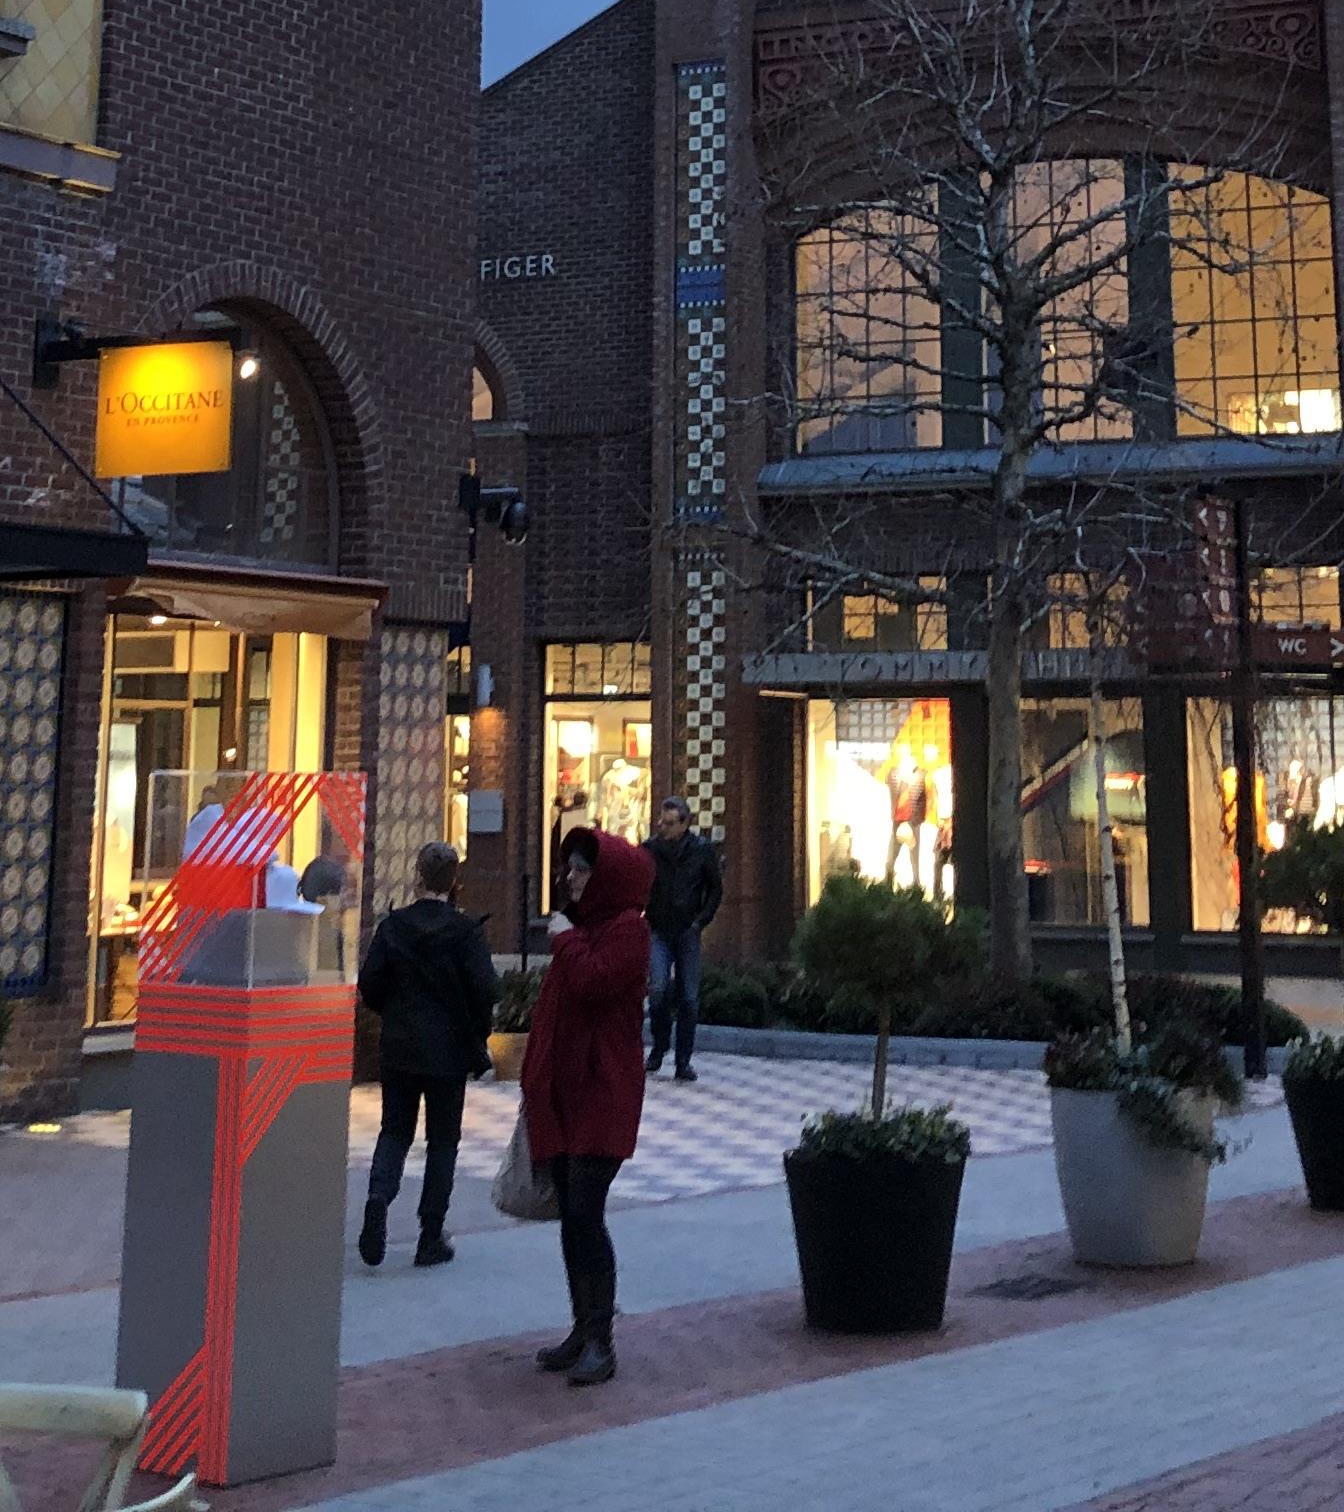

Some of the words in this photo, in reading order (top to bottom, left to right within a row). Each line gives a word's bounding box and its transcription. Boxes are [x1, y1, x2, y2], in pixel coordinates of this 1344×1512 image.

[479, 254, 555, 281] FIGER
[105, 390, 224, 415] L'OCCITANE
[144, 413, 199, 426] PROVENCE
[1278, 638, 1307, 656] WC
